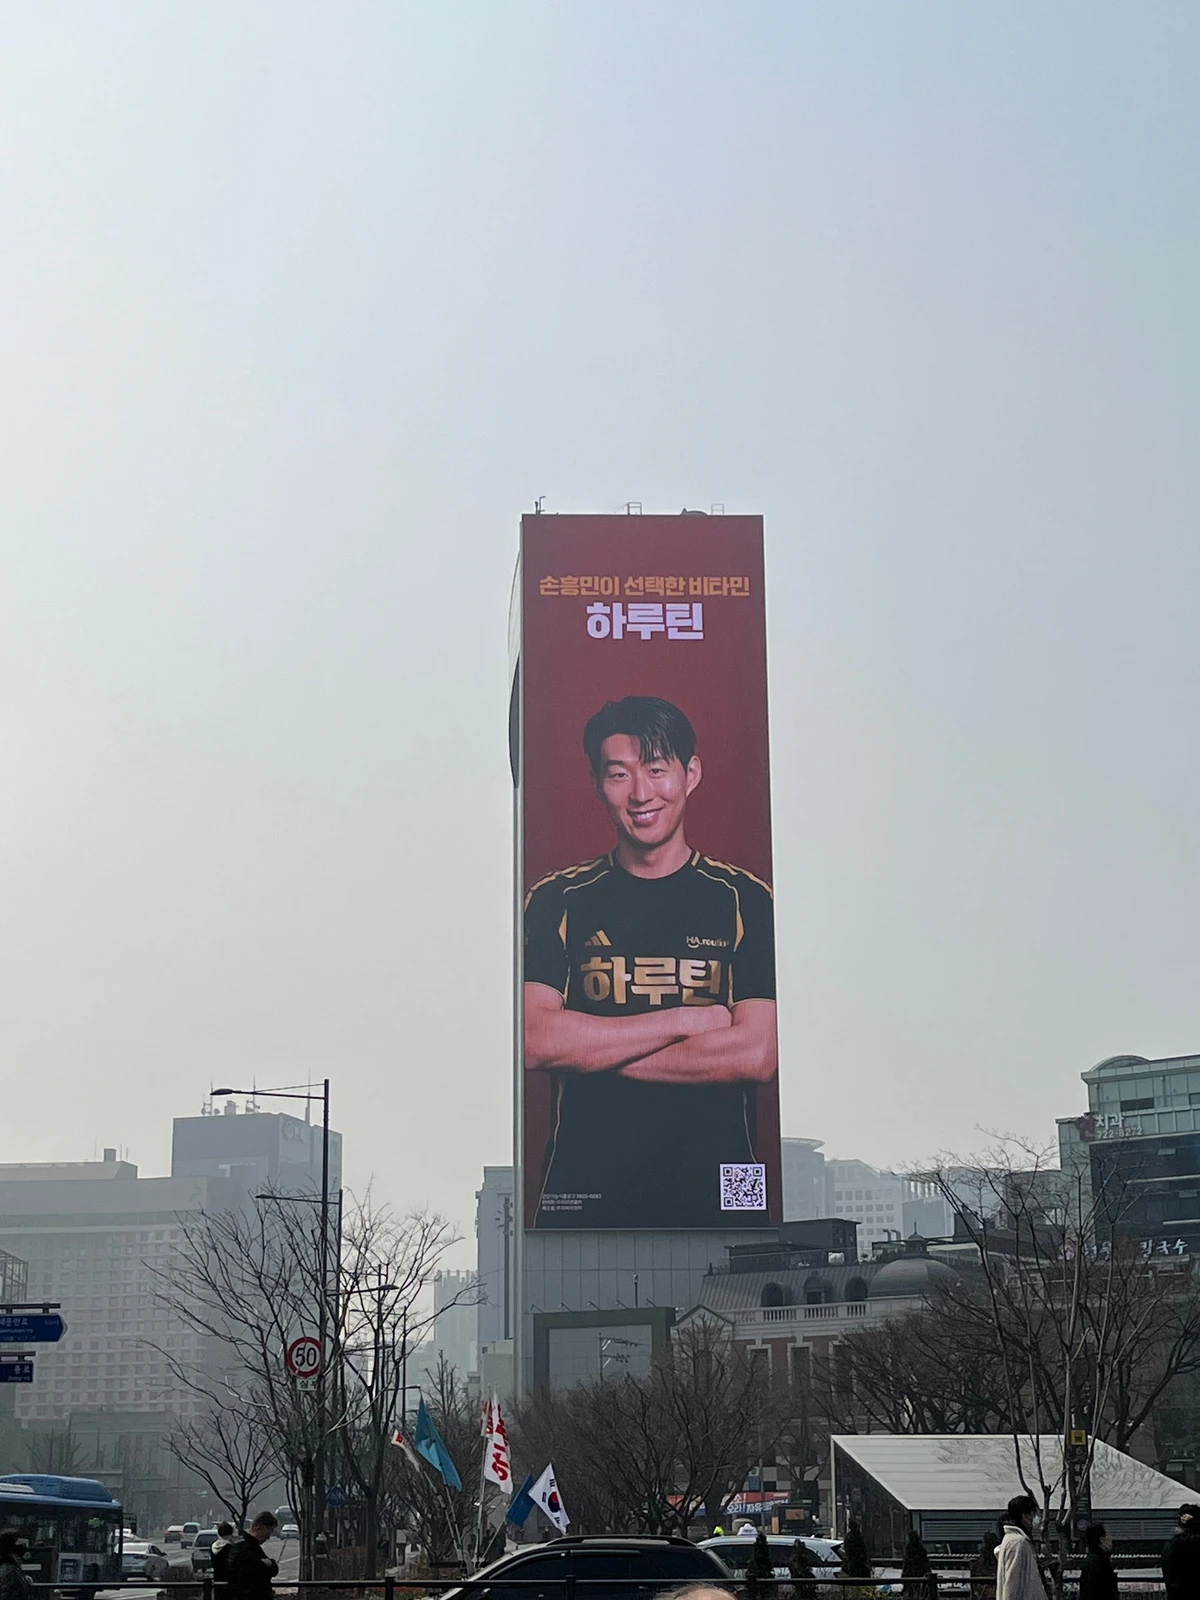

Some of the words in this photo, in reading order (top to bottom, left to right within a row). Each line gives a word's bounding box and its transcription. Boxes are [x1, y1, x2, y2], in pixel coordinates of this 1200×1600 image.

[539, 575, 620, 596] 손흥민이
[624, 576, 686, 596] 선택한
[689, 576, 750, 596] 비타민
[586, 601, 704, 640] 하루틴
[580, 956, 722, 1006] 하루틴
[1095, 1112, 1124, 1131] 치과
[295, 1347, 316, 1367] 50
